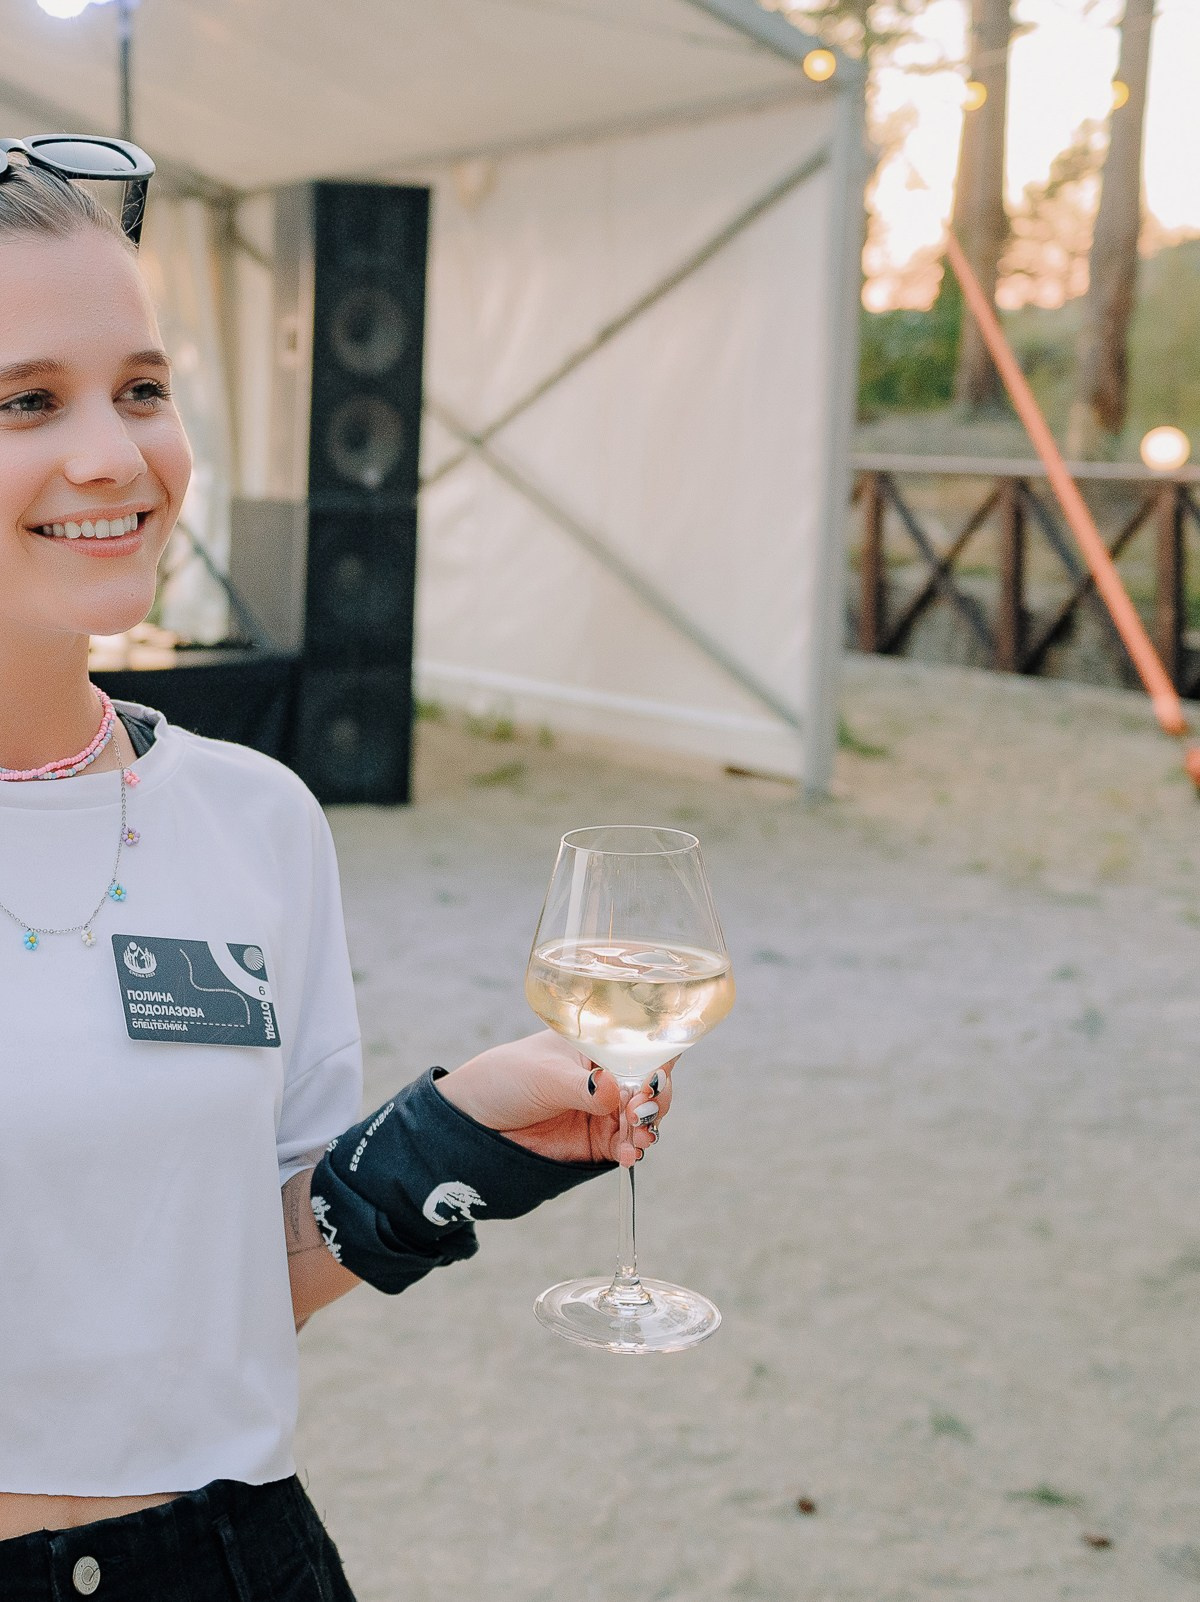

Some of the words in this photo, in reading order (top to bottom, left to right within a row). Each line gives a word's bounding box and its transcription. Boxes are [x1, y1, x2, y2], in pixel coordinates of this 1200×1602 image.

[127, 990, 175, 1003] ПОЛИНА
[258, 985, 266, 996] 6
[129, 1003, 205, 1019] ВОДОЛАЗОВА
[132, 1020, 188, 1032] СПЕЦТЕХНИКА
[260, 1002, 276, 1040] ОТРЯД
[365, 1102, 395, 1137] СМЕНА
[349, 1137, 368, 1172] 2023
